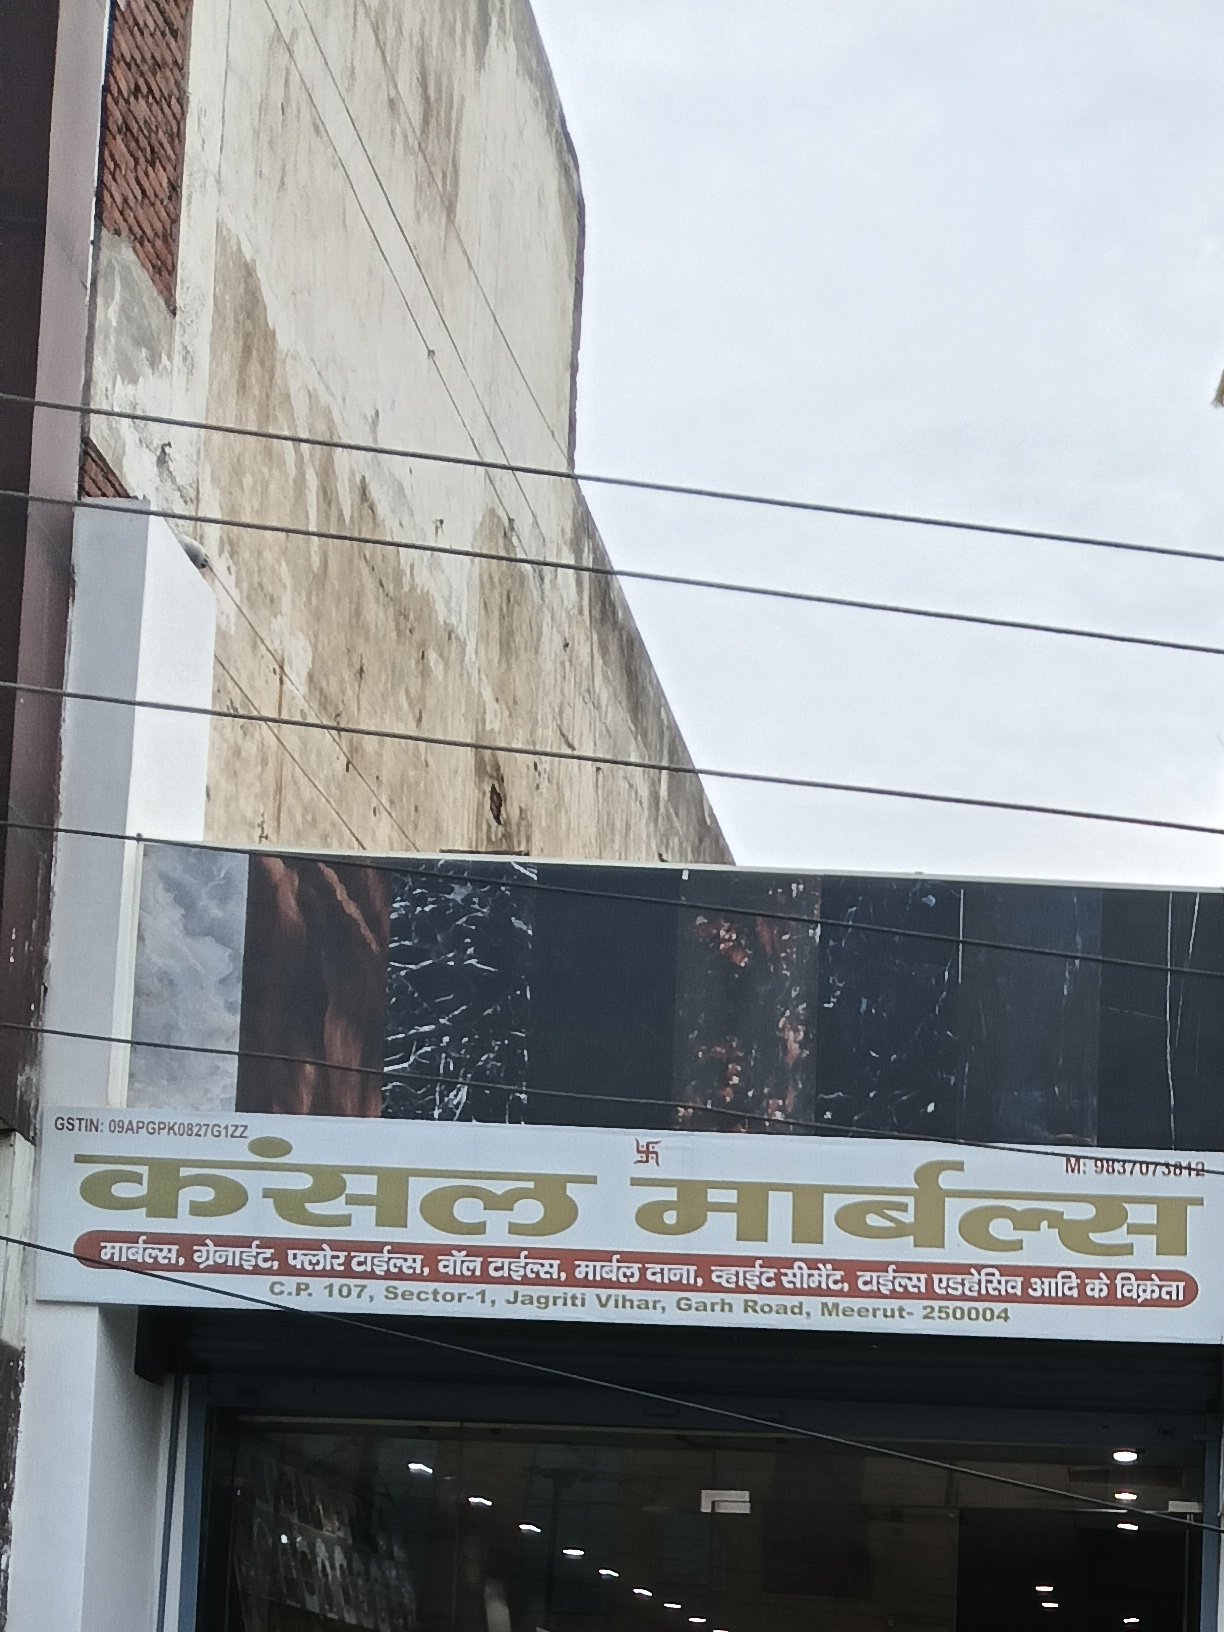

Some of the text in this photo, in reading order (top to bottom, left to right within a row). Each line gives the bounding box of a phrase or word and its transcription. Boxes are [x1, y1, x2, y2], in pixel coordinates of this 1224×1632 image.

[54, 1116, 104, 1134] GSTIN:
[1065, 1156, 1206, 1178] M: 9837073812
[73, 1136, 1204, 1257] कंसल मार्बल्स
[100, 1236, 1185, 1303] मार्बल्स, ग्रेनाईट, फ्लोर टाईल्स, वॉल टाईल्स, मार्बल दाना, व्हाईट सीमेंट, टाईल्स एडहेसिव आदि के विक्रेता
[268, 1280, 313, 1298] C.P.
[323, 1282, 374, 1303] 107,
[384, 1285, 496, 1308] Sector-1,
[504, 1289, 586, 1311] Jagriti
[595, 1293, 667, 1314] Vihar,
[675, 1296, 734, 1314] Garh
[743, 1298, 812, 1319] Road,
[921, 1304, 1010, 1323] 250004
